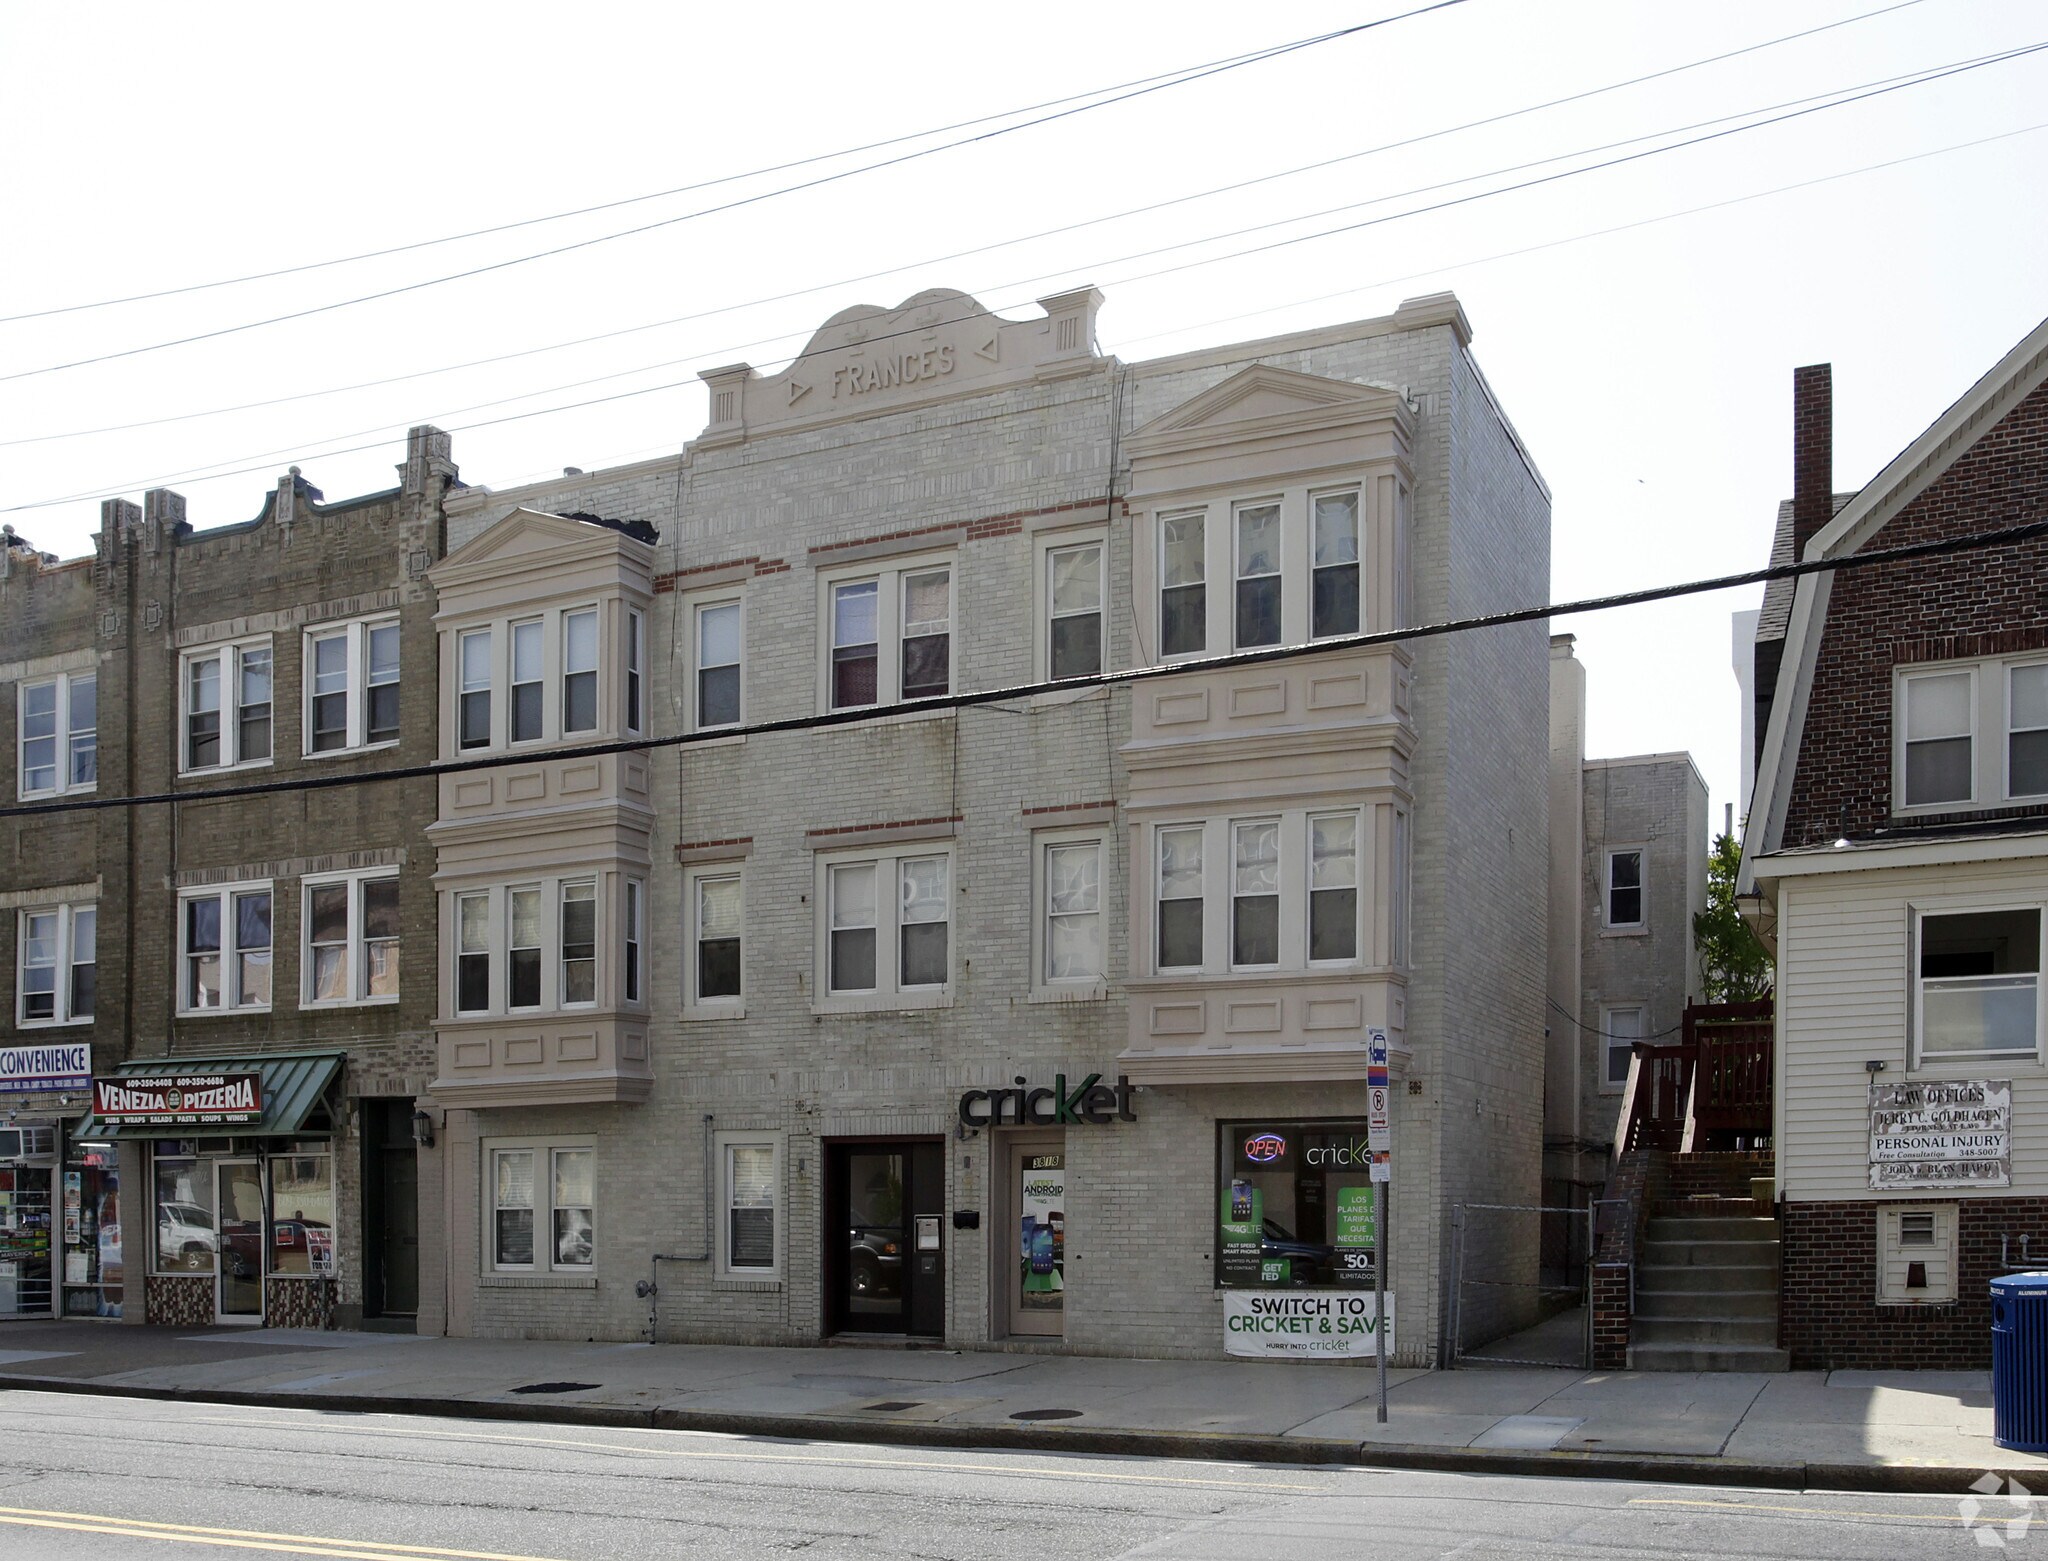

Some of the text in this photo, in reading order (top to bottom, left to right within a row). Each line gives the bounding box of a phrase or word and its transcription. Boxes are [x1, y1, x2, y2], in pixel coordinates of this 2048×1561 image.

[831, 345, 956, 399] FRANCES
[0, 1047, 85, 1074] CONVENIENCE
[98, 1081, 166, 1111] VENEZIA
[183, 1078, 254, 1109] PIZZERIA
[959, 1073, 1137, 1126] cricket
[1895, 1088, 1985, 1105] LAW OFFICES
[105, 1116, 120, 1124] SUBS
[150, 1115, 172, 1123] SALADS
[201, 1114, 222, 1122] SOUPS
[1879, 1111, 1913, 1125] JERRY
[1245, 1140, 1286, 1156] OPEN
[1876, 1134, 2003, 1149] PERSONAL INJURY
[1307, 1137, 1371, 1165] cricke
[1897, 1151, 1945, 1159] Consultation
[1960, 1148, 1998, 1157] 348-5007
[1024, 1185, 1064, 1193] ANDROID
[1263, 1263, 1283, 1272] GET
[1344, 1253, 1368, 1269] $50
[1251, 1298, 1365, 1315] SWITCH TO
[1228, 1315, 1391, 1334] CRICKET & SAVE
[1309, 1339, 1350, 1350] cricket
